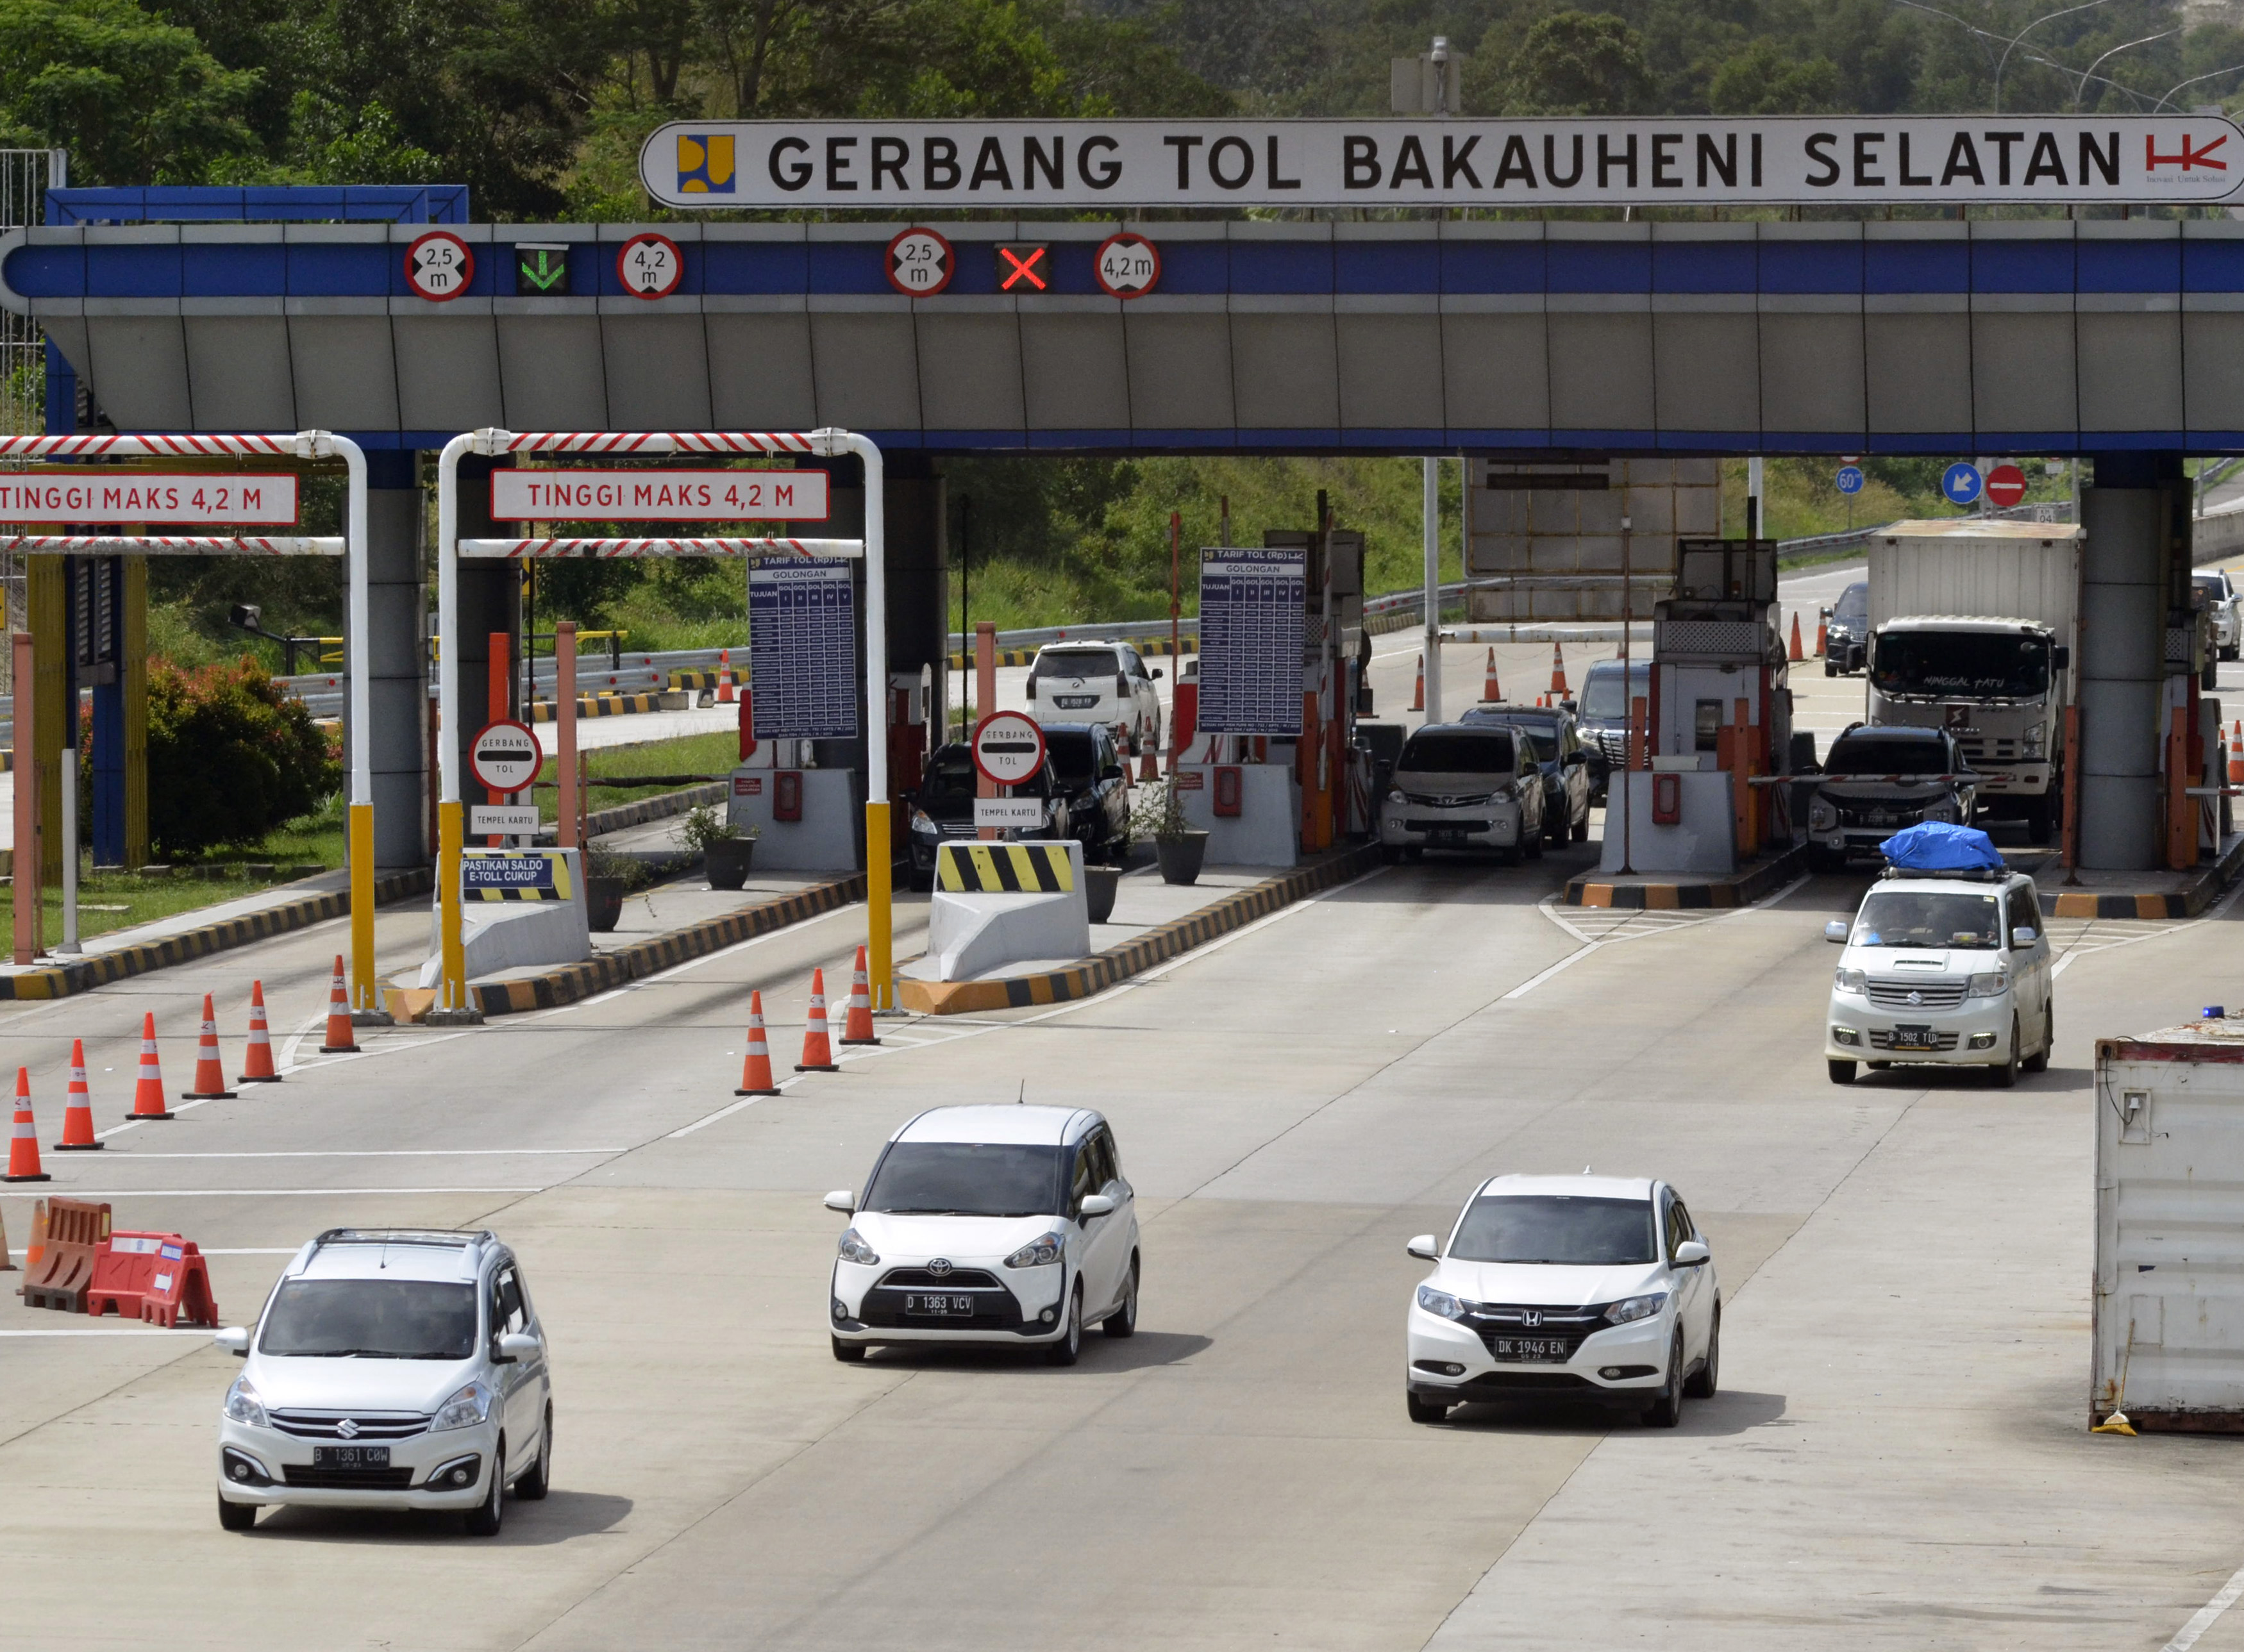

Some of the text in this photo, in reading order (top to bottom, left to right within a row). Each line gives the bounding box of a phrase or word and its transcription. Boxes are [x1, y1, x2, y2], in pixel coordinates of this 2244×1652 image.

[2146, 134, 2227, 171] HK
[769, 131, 2120, 191] GERBANG TOL BAKAUHENI SELATAN
[426, 248, 452, 269] 2,5
[635, 251, 665, 269] 4,2
[905, 244, 932, 263] 2,5
[1104, 257, 1151, 277] 4,2 m
[430, 271, 448, 287] m
[642, 270, 657, 284] m
[910, 267, 928, 283] m
[1840, 473, 1854, 488] 60
[1, 487, 262, 514] TINGGI MAKS 4,2 M
[528, 484, 793, 512] TINGGI MAKS 4,2 M
[773, 571, 826, 579] GOLONGAN
[1227, 565, 1280, 573] GOLONGAN
[1924, 676, 1970, 687] NINGGAL
[464, 860, 543, 871] PASTIKAN SALDO
[469, 872, 537, 881] E-TOLL CUKUP
[1889, 1032, 1894, 1041] B
[1900, 1033, 1918, 1042] 1502
[908, 1296, 971, 1309] D 1363 VCV
[1498, 1340, 1564, 1354] DK 1946 EN
[315, 1448, 321, 1461] B
[336, 1449, 360, 1462] 1361
